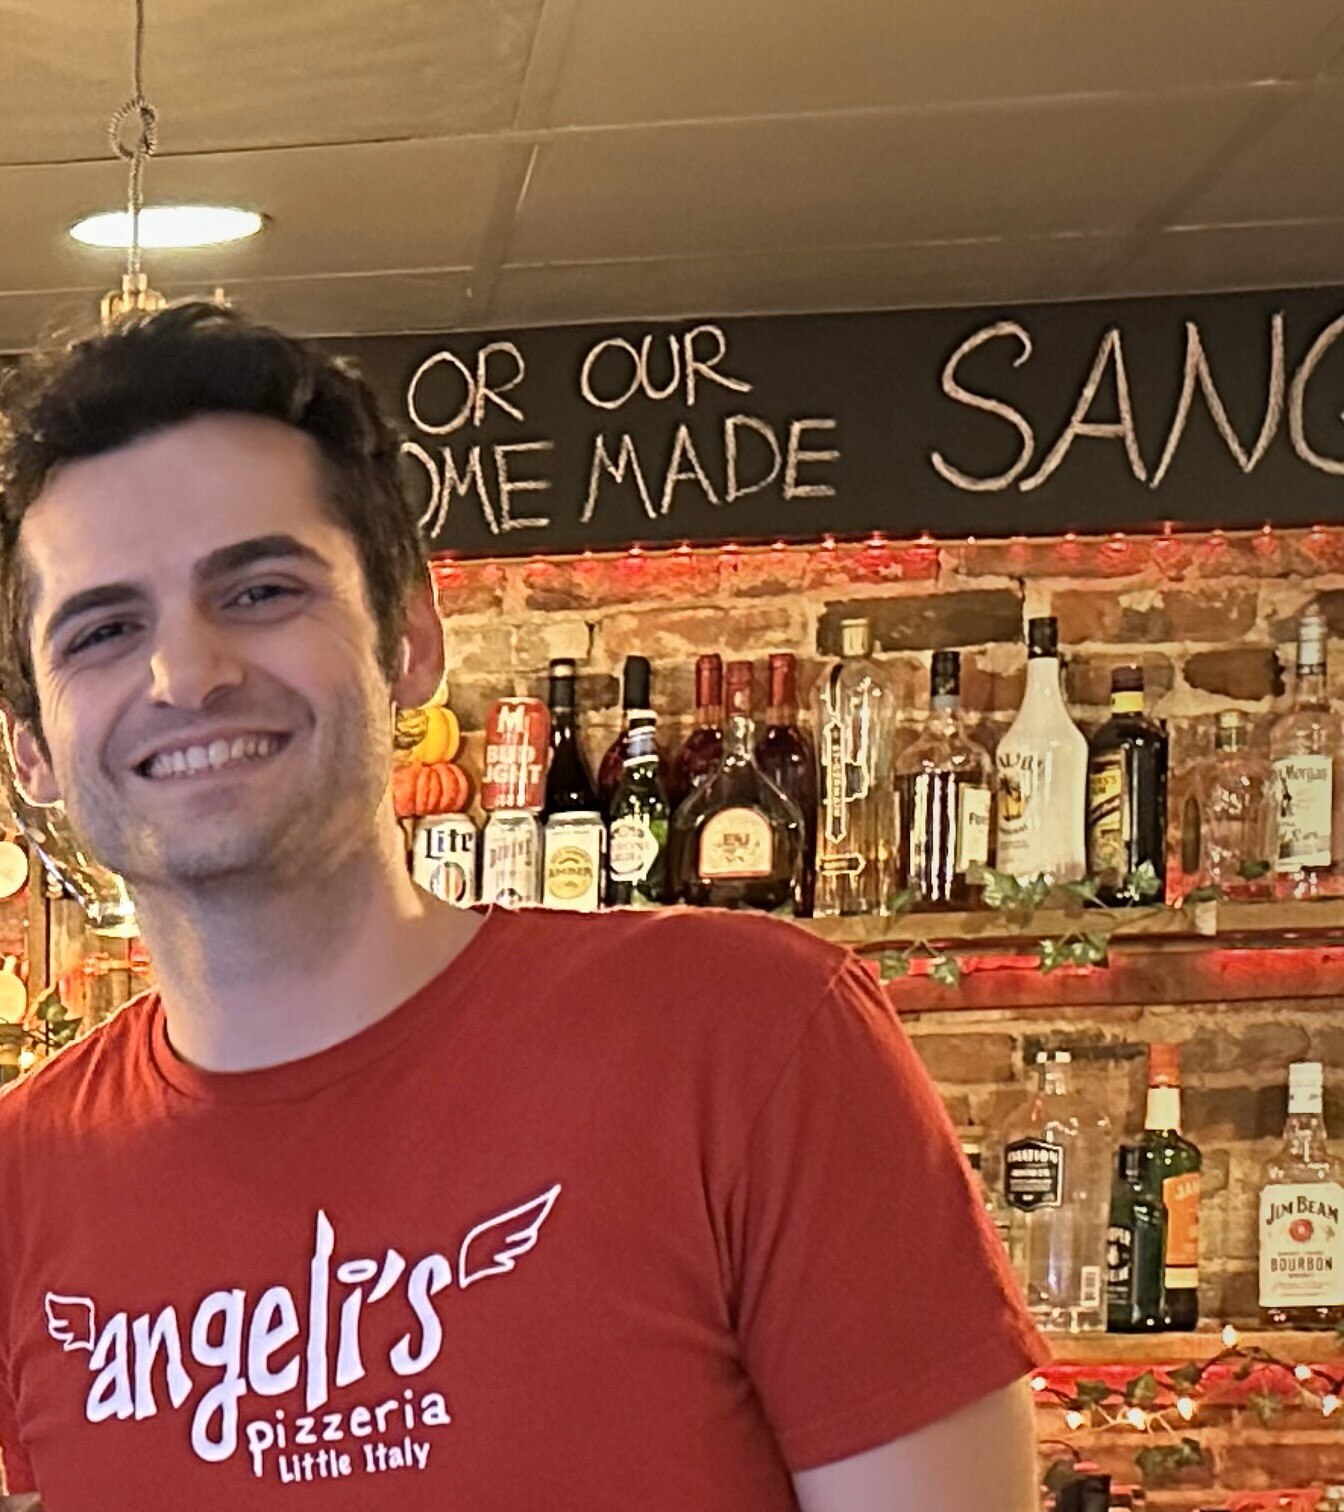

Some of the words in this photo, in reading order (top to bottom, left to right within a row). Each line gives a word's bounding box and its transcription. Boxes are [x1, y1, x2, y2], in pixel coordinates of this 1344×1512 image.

[408, 341, 525, 435] OR
[579, 324, 753, 410] OUR
[400, 438, 555, 540] OME
[580, 414, 841, 524] MADE
[1285, 764, 1328, 783] Morgan
[424, 828, 474, 860] Lite
[1265, 1202, 1294, 1226] JIM
[1296, 1195, 1339, 1225] BEAM
[1270, 1256, 1333, 1273] BOURBON
[86, 1209, 452, 1462] angeli's
[246, 1388, 452, 1478] pizzeria
[278, 1448, 352, 1484] Little
[363, 1436, 431, 1474] Italy
